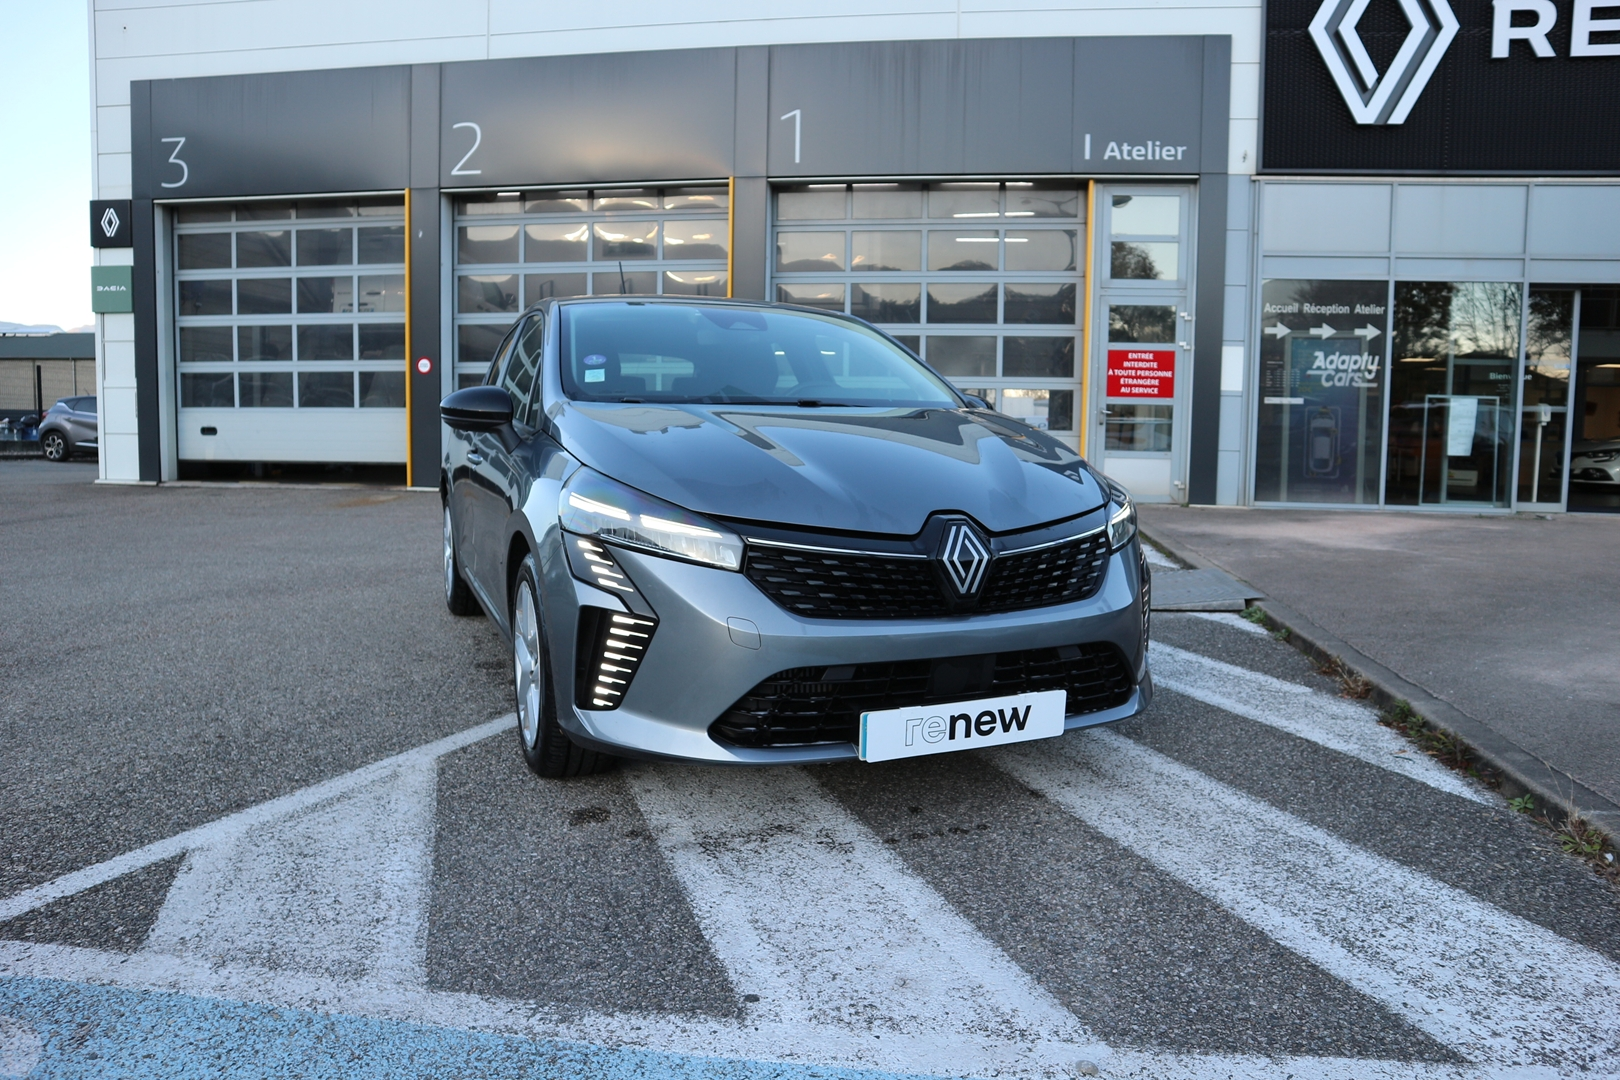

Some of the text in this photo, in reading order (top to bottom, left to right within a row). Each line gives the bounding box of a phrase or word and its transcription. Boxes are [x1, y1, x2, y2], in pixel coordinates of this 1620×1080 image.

[780, 109, 801, 163] 1
[451, 121, 482, 175] 2
[1103, 140, 1187, 160] Atelier
[160, 136, 189, 188] 3
[1264, 302, 1386, 316] Accueil Réception Atelier
[1128, 351, 1154, 360] ENTRÉE
[1123, 361, 1158, 369] INTERDITE
[1137, 370, 1173, 378] PERSONNE
[1312, 351, 1380, 379] Adapty
[1120, 377, 1160, 386] ÉTRANGÈRE
[1306, 370, 1378, 387] Cars
[905, 705, 1032, 747] renew
